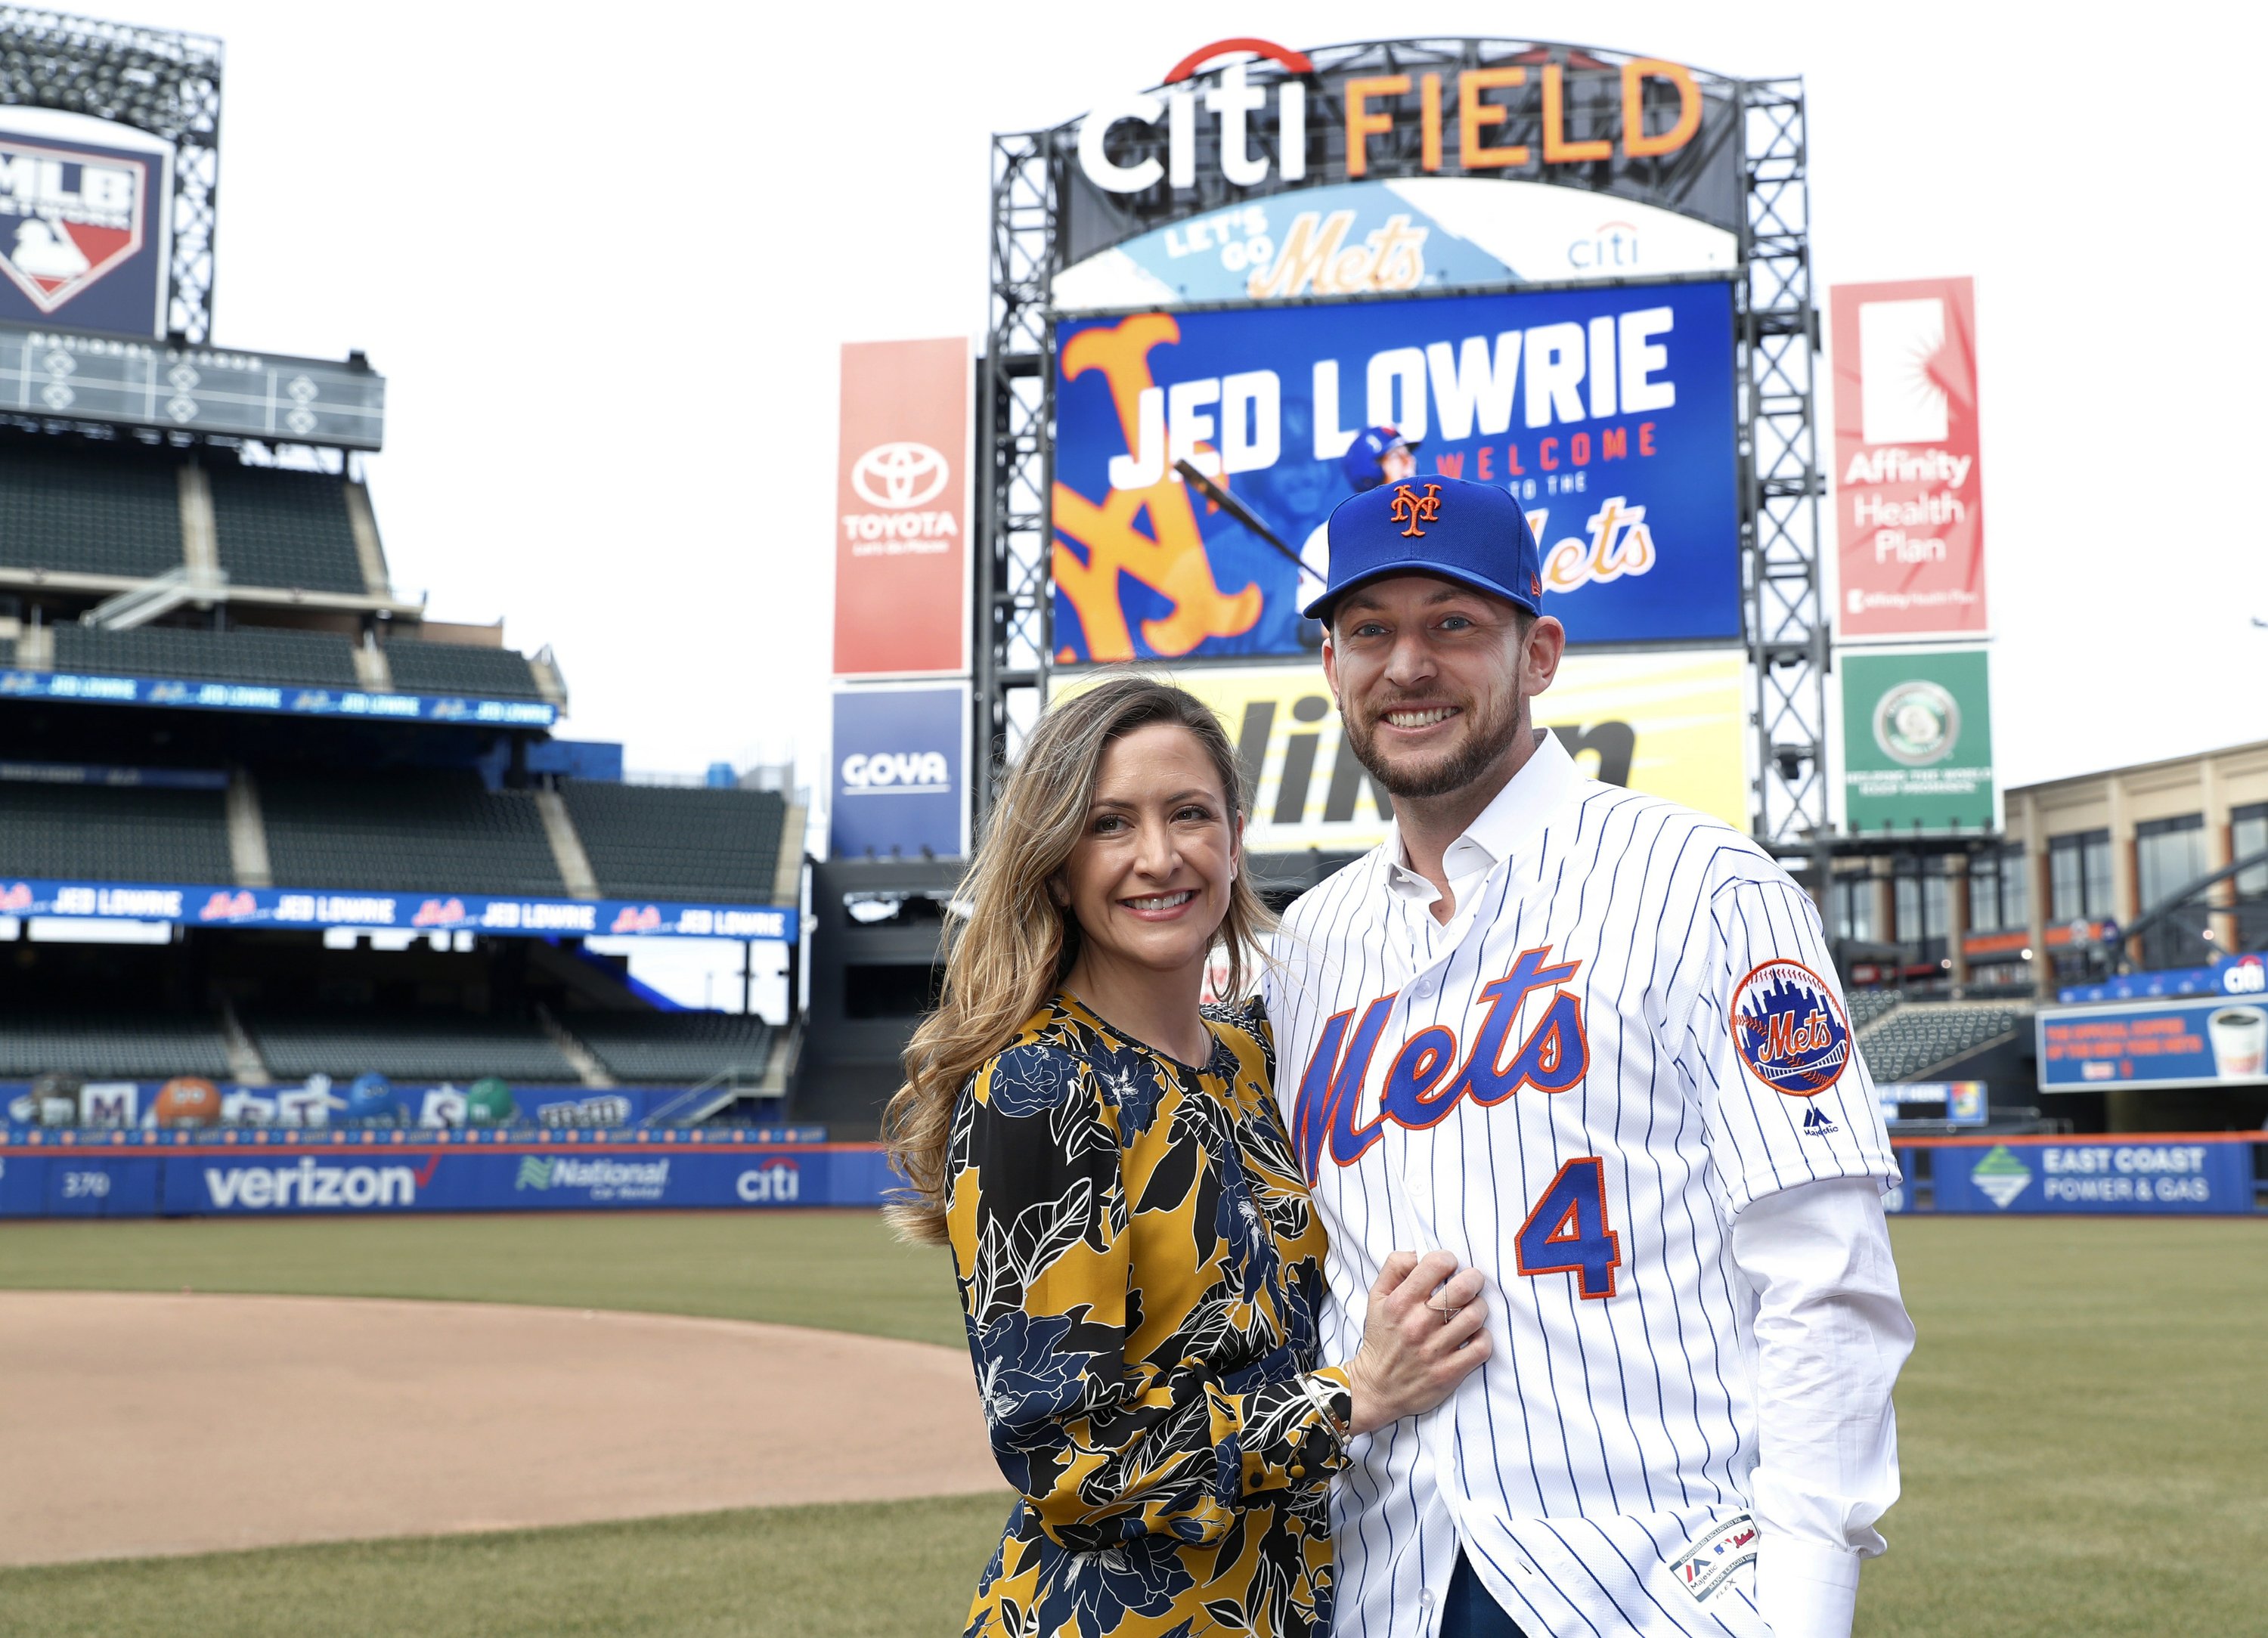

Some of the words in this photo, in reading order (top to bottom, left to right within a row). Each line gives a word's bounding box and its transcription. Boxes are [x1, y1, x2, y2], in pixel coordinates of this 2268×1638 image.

[1077, 64, 1306, 193] citi
[1346, 59, 1704, 178] FIELD
[1163, 204, 1269, 259] LET'S
[1221, 234, 1275, 272] GO
[1247, 208, 1431, 299] Mets
[1567, 233, 1638, 268] citi
[1109, 369, 1281, 491] JED
[1314, 305, 1676, 461] LOWRIE
[1437, 421, 1657, 479] WELCOME
[1545, 470, 1587, 496] THE
[1843, 447, 1972, 490] Affinity
[841, 509, 959, 541] TOYOTA
[1854, 490, 1966, 528] Health
[1875, 530, 1947, 564] Plan
[52, 887, 96, 914] JED
[97, 890, 182, 917] LOWRIE
[272, 895, 315, 921] JED
[316, 896, 397, 924] LOWRIE
[481, 902, 520, 927] JED
[521, 903, 596, 930] LOWRIE
[676, 909, 713, 934] JED
[714, 911, 785, 937] LOWRIE
[1758, 1009, 1833, 1063] Mets
[1291, 944, 1590, 1190] Mets
[1804, 1125, 1839, 1138] Majestic
[552, 1158, 671, 1187] National
[2043, 1147, 2112, 1174] EAST
[2114, 1146, 2207, 1173] COAST
[62, 1172, 111, 1198] 370
[205, 1156, 416, 1209] verizon
[736, 1163, 799, 1203] citi
[2043, 1177, 2133, 1202] POWER
[2134, 1178, 2153, 1201] &
[2155, 1177, 2210, 1202] GAS
[1514, 1157, 1622, 1300] 4
[1690, 1565, 1718, 1590] Majestic
[1708, 1574, 1726, 1590] MAJOR
